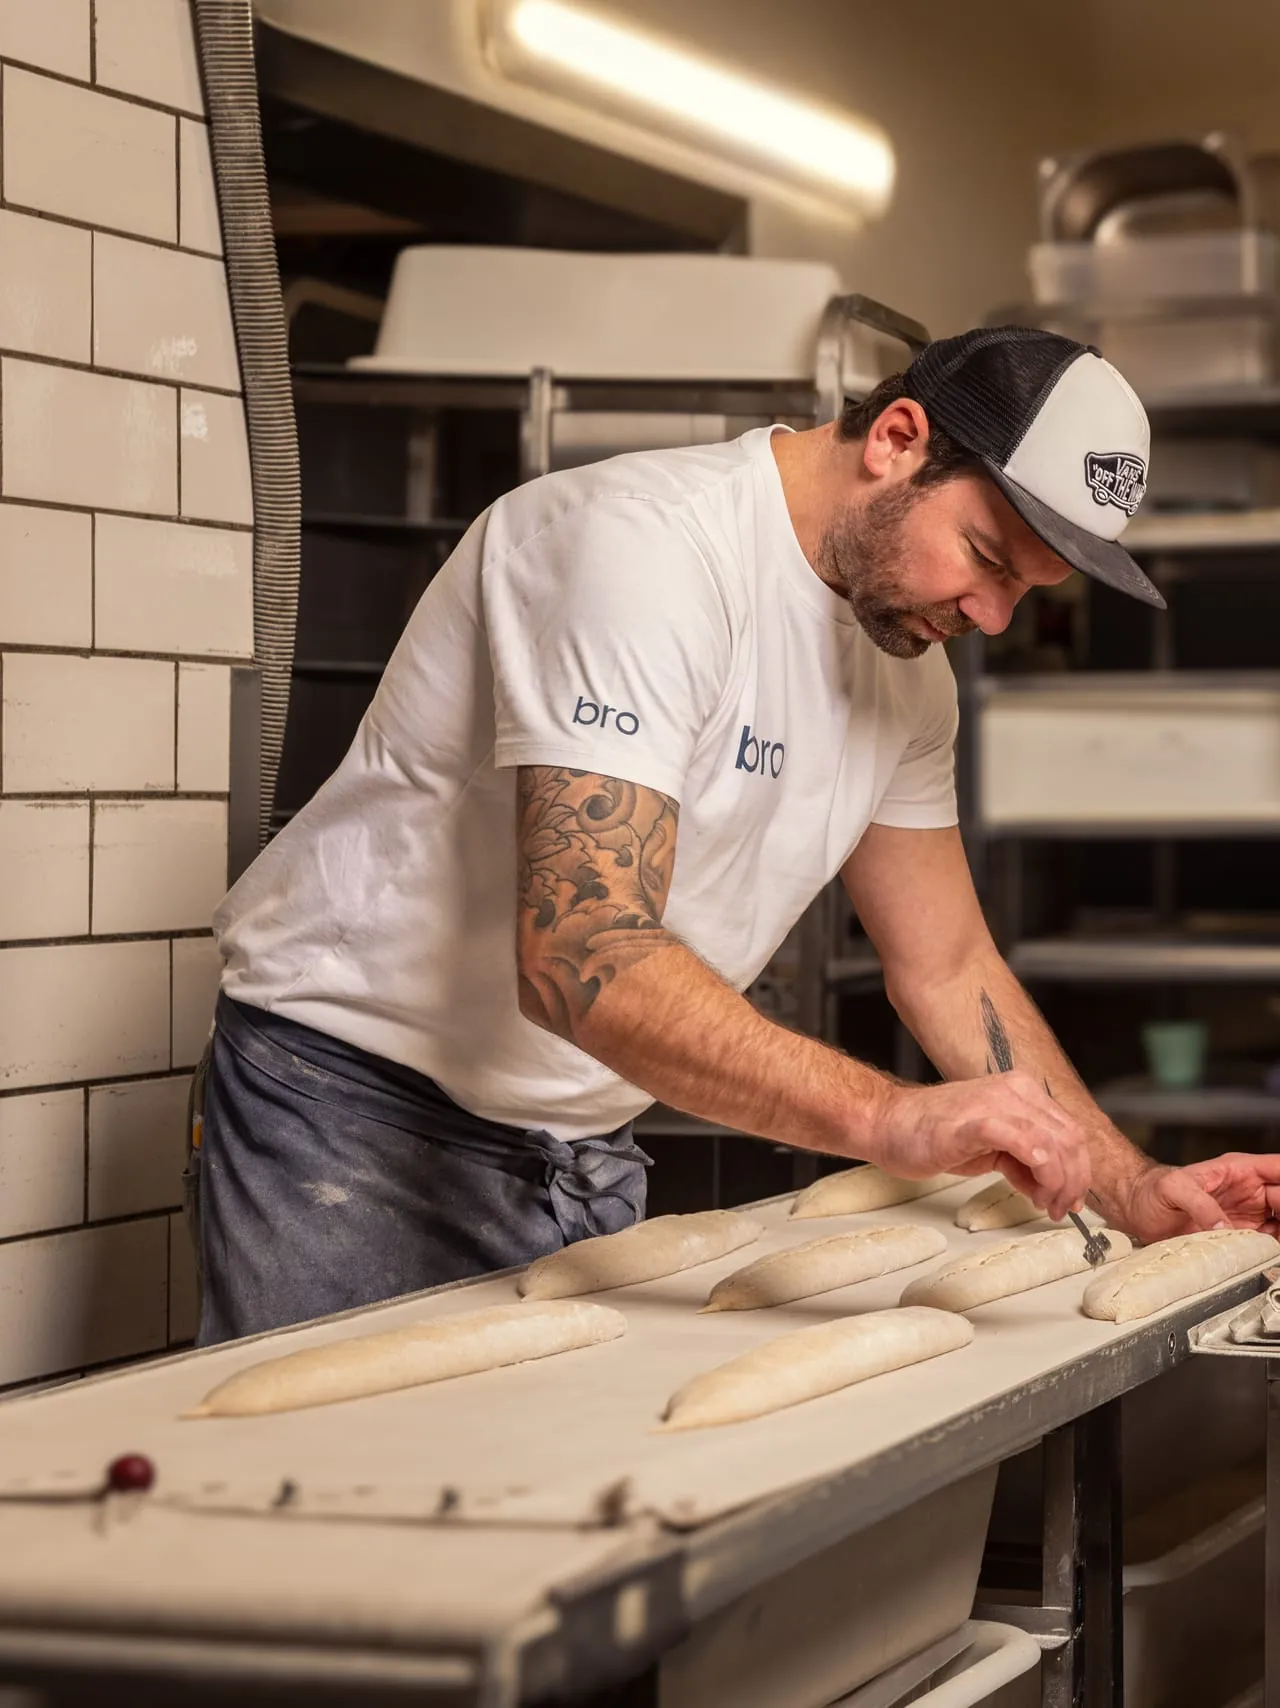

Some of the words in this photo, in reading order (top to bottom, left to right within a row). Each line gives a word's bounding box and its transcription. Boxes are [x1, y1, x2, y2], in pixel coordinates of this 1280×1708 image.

[1116, 457, 1142, 481] VANS
[1113, 475, 1134, 501] THE
[572, 696, 640, 736] bro
[735, 725, 785, 779] bro
